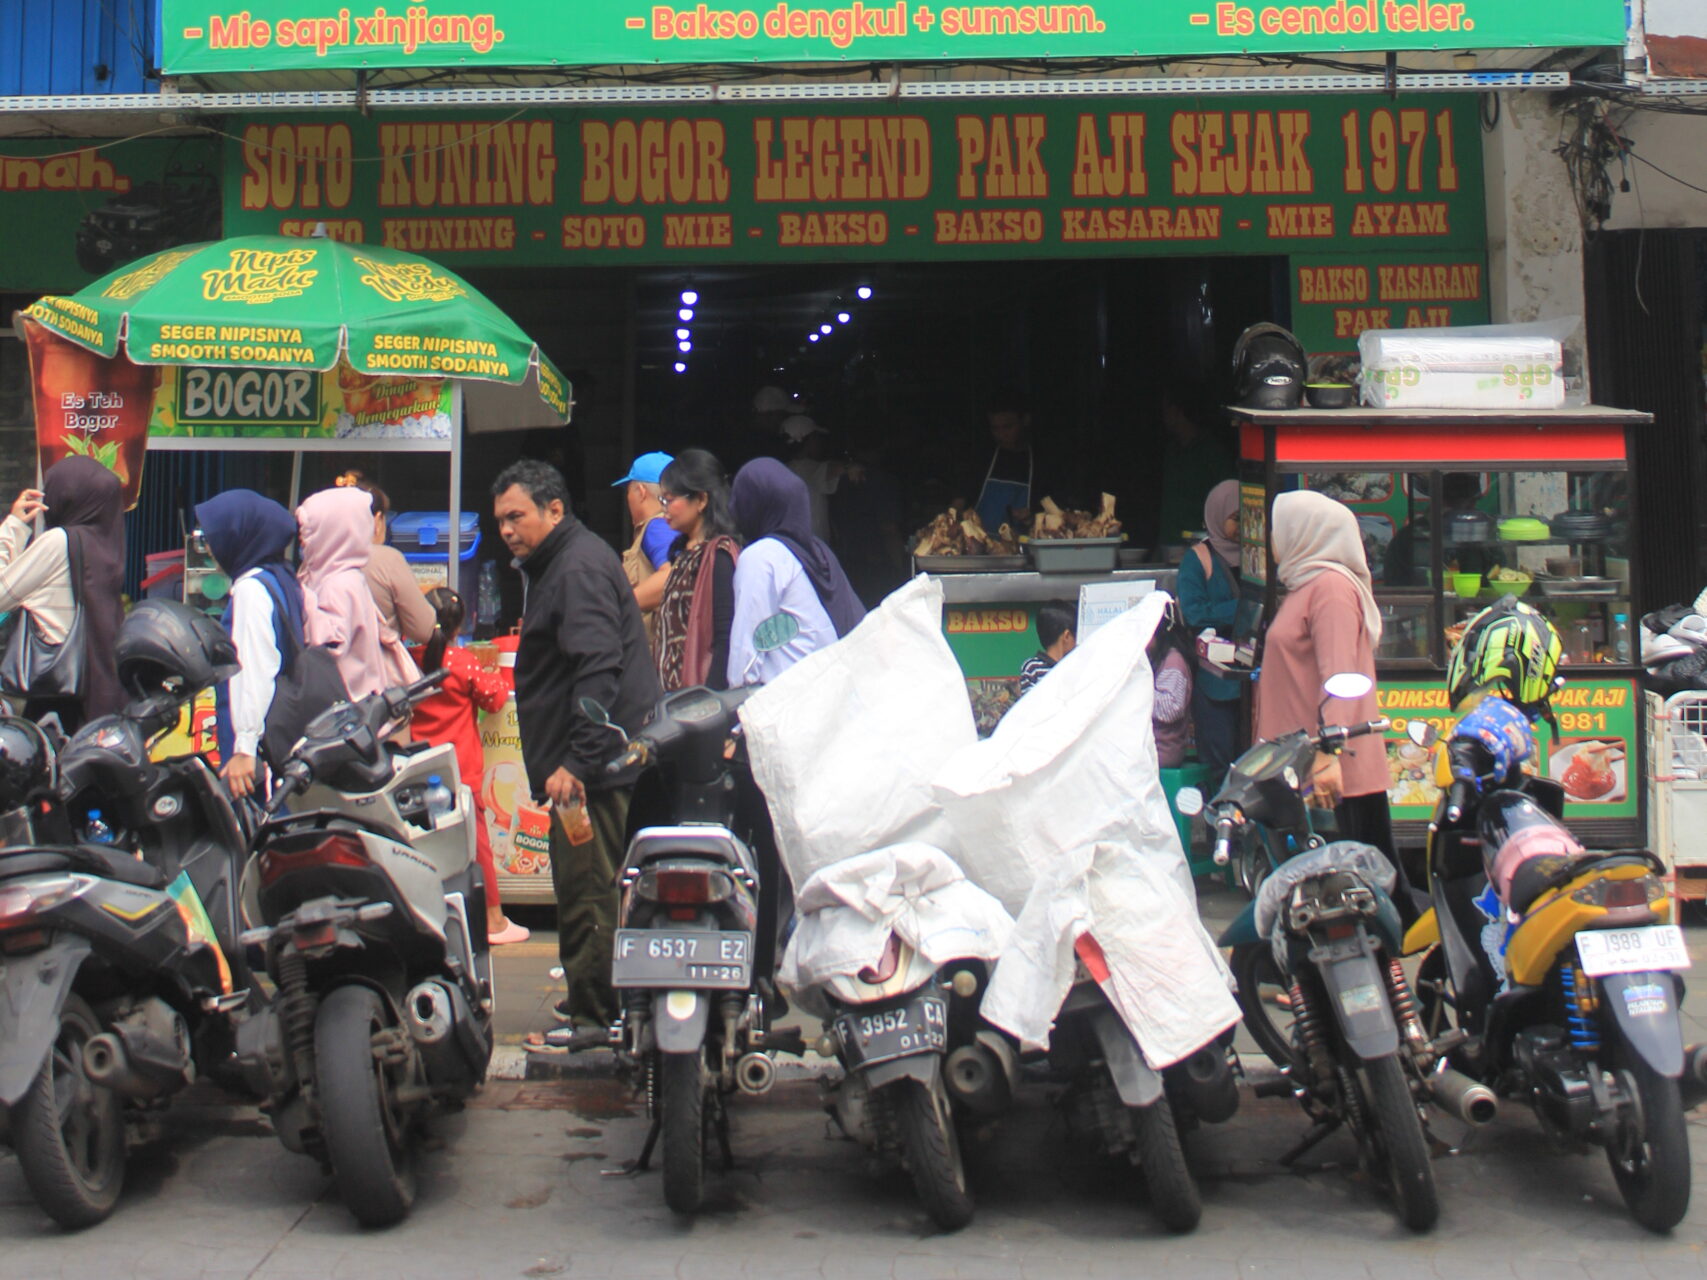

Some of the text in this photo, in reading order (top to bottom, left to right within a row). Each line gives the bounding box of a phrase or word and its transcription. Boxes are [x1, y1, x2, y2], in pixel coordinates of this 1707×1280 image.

[651, 5, 758, 41] Bakso
[762, 1, 907, 48] dengkul
[914, 8, 934, 32] +
[942, 1, 1106, 36] sumsum.
[1216, 2, 1255, 36] Es
[1259, 0, 1380, 34] cendol
[210, 15, 272, 51] Mie
[278, 12, 352, 56] sapi
[356, 7, 504, 55] xinjiang.
[0, 145, 132, 194] nah.
[241, 106, 1458, 210] SOTO KUNING BOGOR LEGEND PAK AJI SEJAK 1971
[381, 217, 516, 251] KUNING
[562, 215, 646, 249] SOTO
[663, 213, 733, 248] MIE
[778, 211, 888, 246] BAKSO
[934, 208, 1044, 245] BAKSO
[1060, 205, 1221, 241] KASARAN
[1266, 204, 1335, 238] MIE
[1351, 202, 1449, 237] AYAM
[230, 249, 318, 273] Nipis
[202, 266, 318, 300] Madu
[1299, 265, 1481, 304] BAKSO KASARAN
[160, 325, 303, 344] SEGER NIPISNYA
[1334, 306, 1450, 339] PAK AJI
[151, 343, 315, 363] SMOOTH SODANYA
[374, 334, 498, 358] SEGER NIPISNYA
[366, 353, 510, 377] SMOOTH SODANYA
[1503, 363, 1553, 387] GPS
[60, 392, 124, 410] Es Teh
[185, 368, 313, 418] BOGOR
[64, 412, 119, 433] Bogor
[947, 610, 1029, 633] BAKSO
[1386, 688, 1450, 708] DIMSU
[1549, 687, 1628, 707] PAK AJI
[1553, 712, 1607, 731] 981
[622, 937, 745, 960] F 6537 EZ
[1580, 928, 1676, 955] F 1988 UF
[838, 1001, 945, 1045] F 3952 CA
